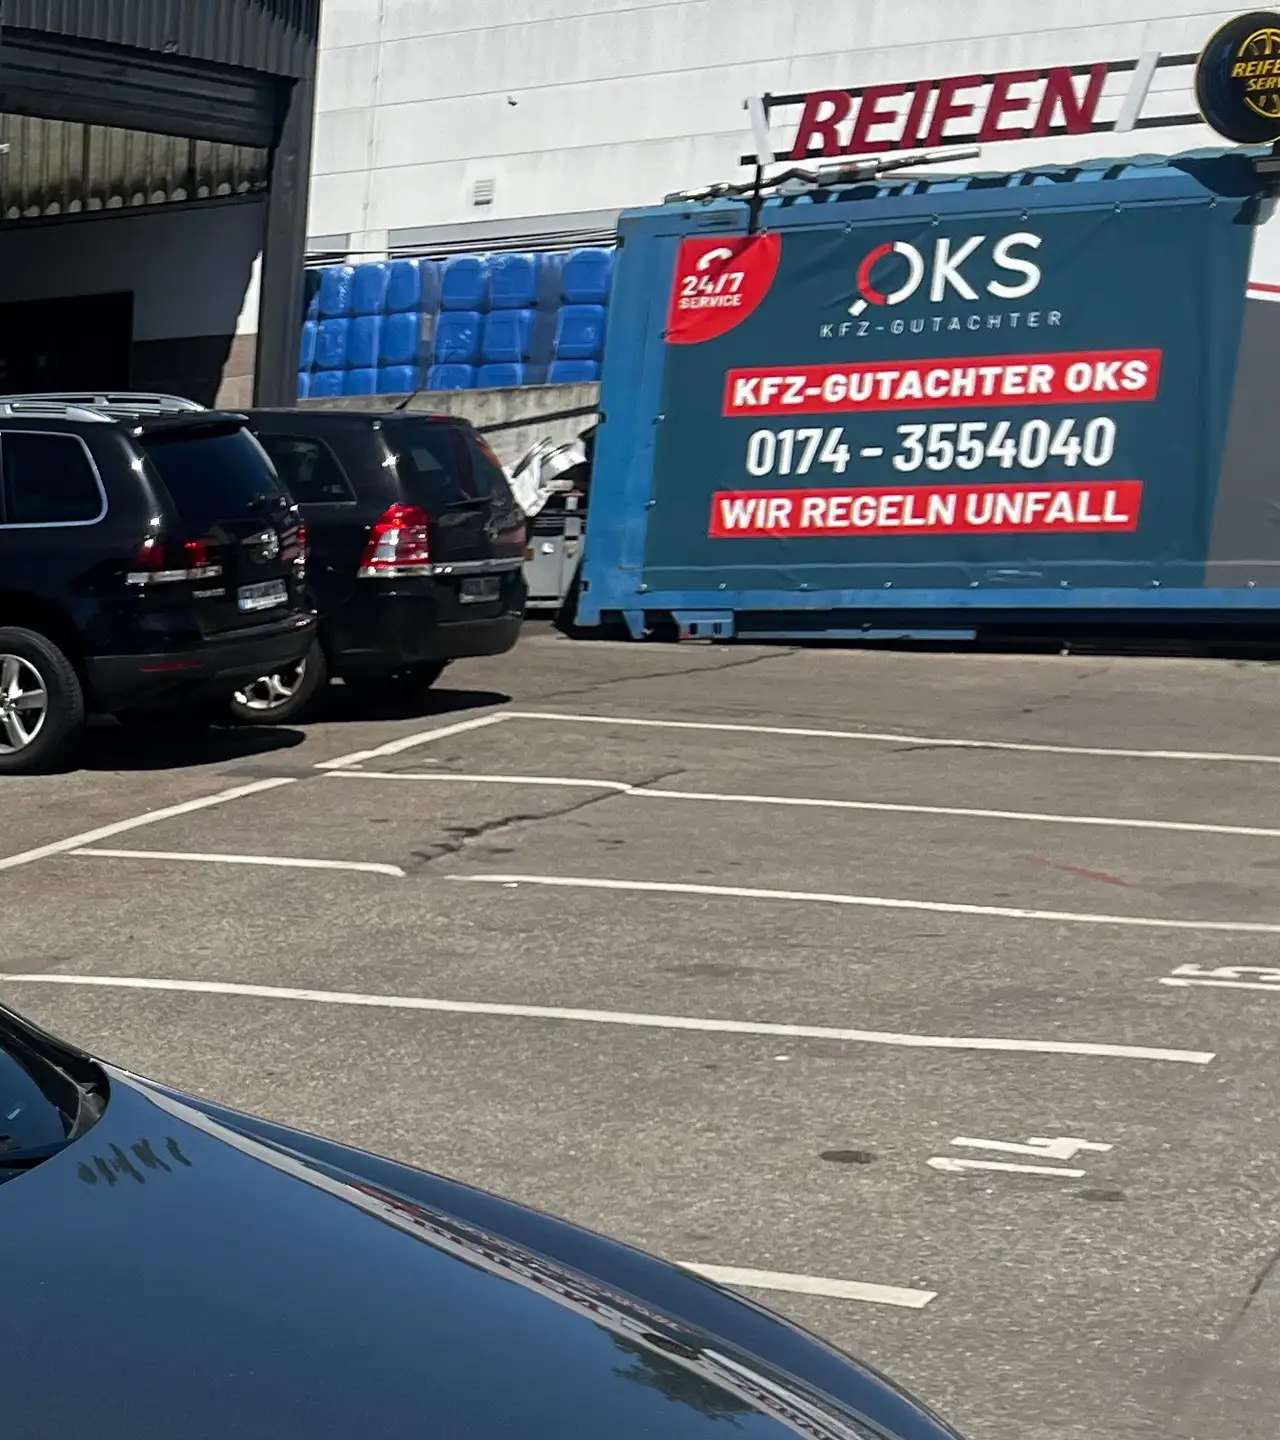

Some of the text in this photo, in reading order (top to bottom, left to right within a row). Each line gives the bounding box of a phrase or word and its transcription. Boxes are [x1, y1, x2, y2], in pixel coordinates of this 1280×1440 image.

[791, 62, 1111, 161] REIFEN
[681, 272, 745, 297] 24/7
[848, 232, 1042, 316] OKS
[679, 294, 743, 310] SERVICE
[819, 311, 1062, 338] KFZ-GUTACHTER
[732, 359, 1150, 407] KFZ-GUTACHTER OKS
[745, 427, 851, 477] 0174
[892, 416, 1116, 473] 3554040
[720, 489, 1129, 530] WIR REGELN UNFALL
